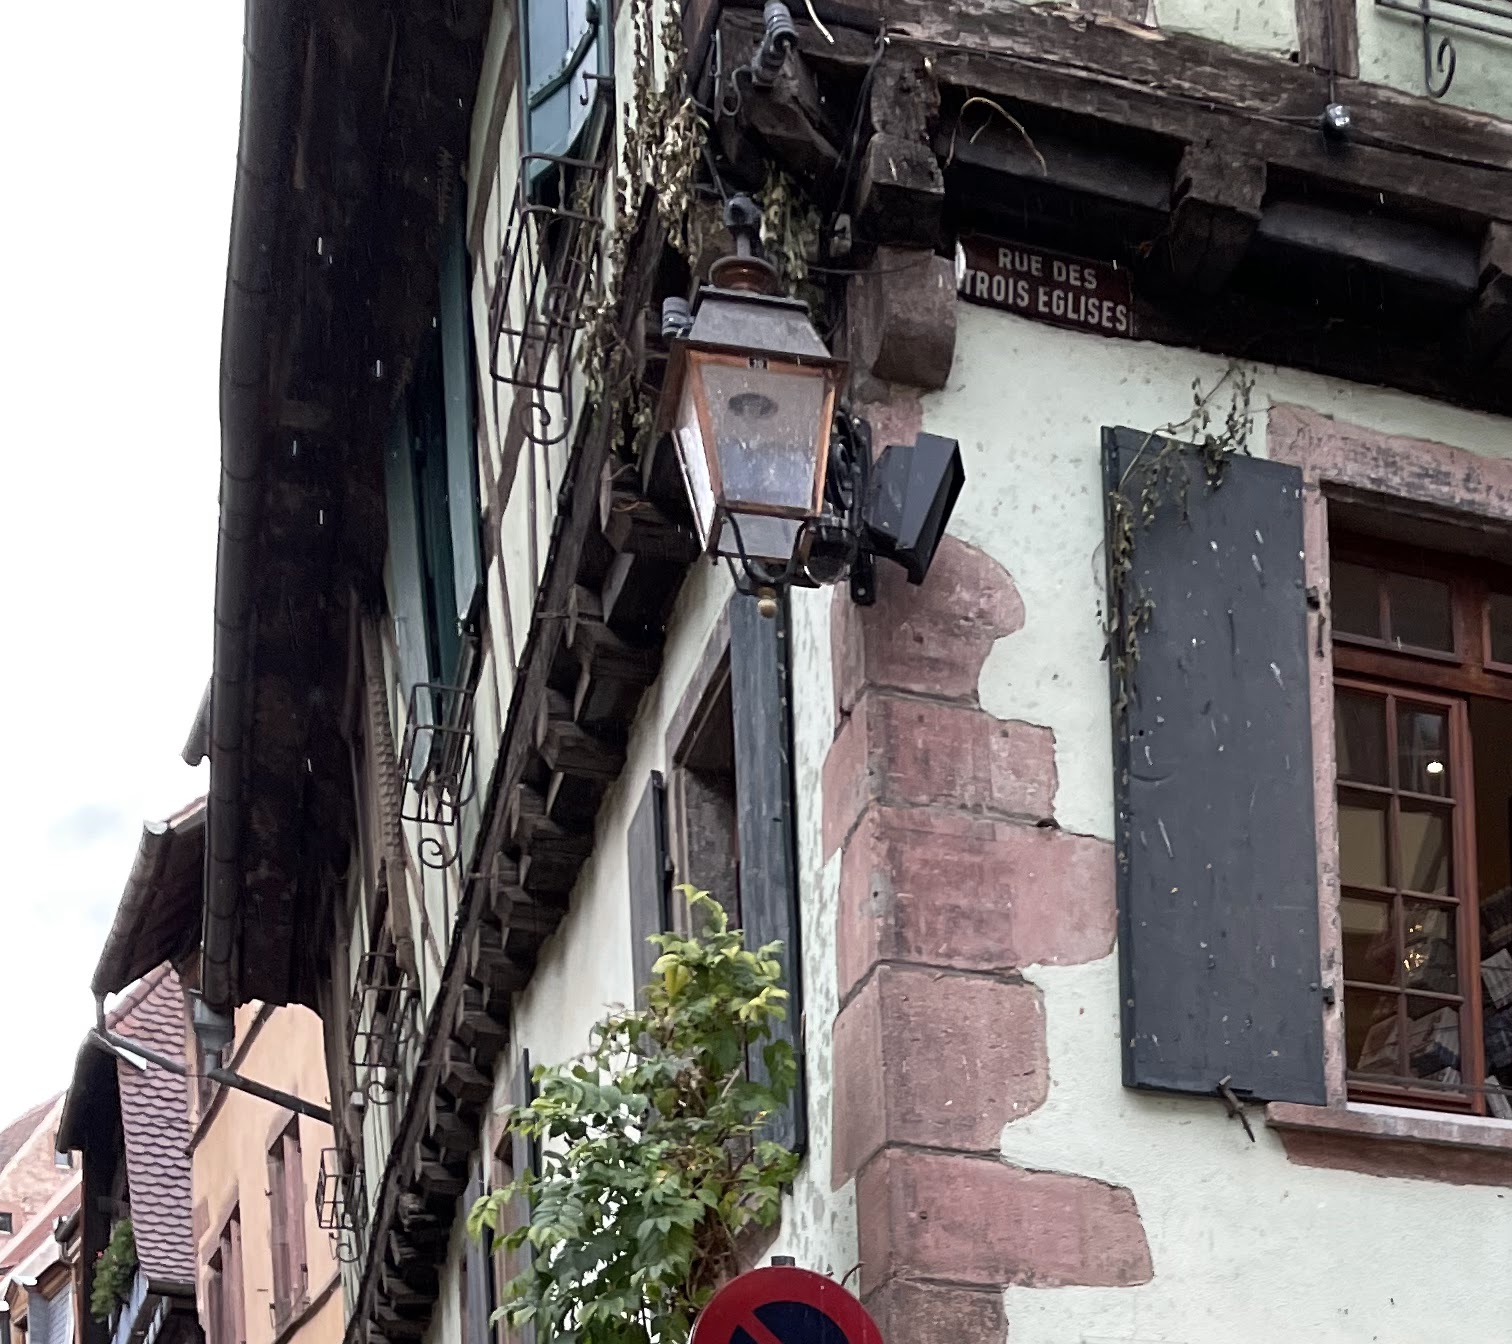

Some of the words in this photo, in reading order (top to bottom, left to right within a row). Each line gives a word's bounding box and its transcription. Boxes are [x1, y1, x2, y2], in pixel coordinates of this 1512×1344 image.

[998, 247, 1043, 277] RUE
[1053, 260, 1097, 289] DES
[963, 269, 1029, 307] TROIS
[1037, 286, 1127, 332] EGLISES
